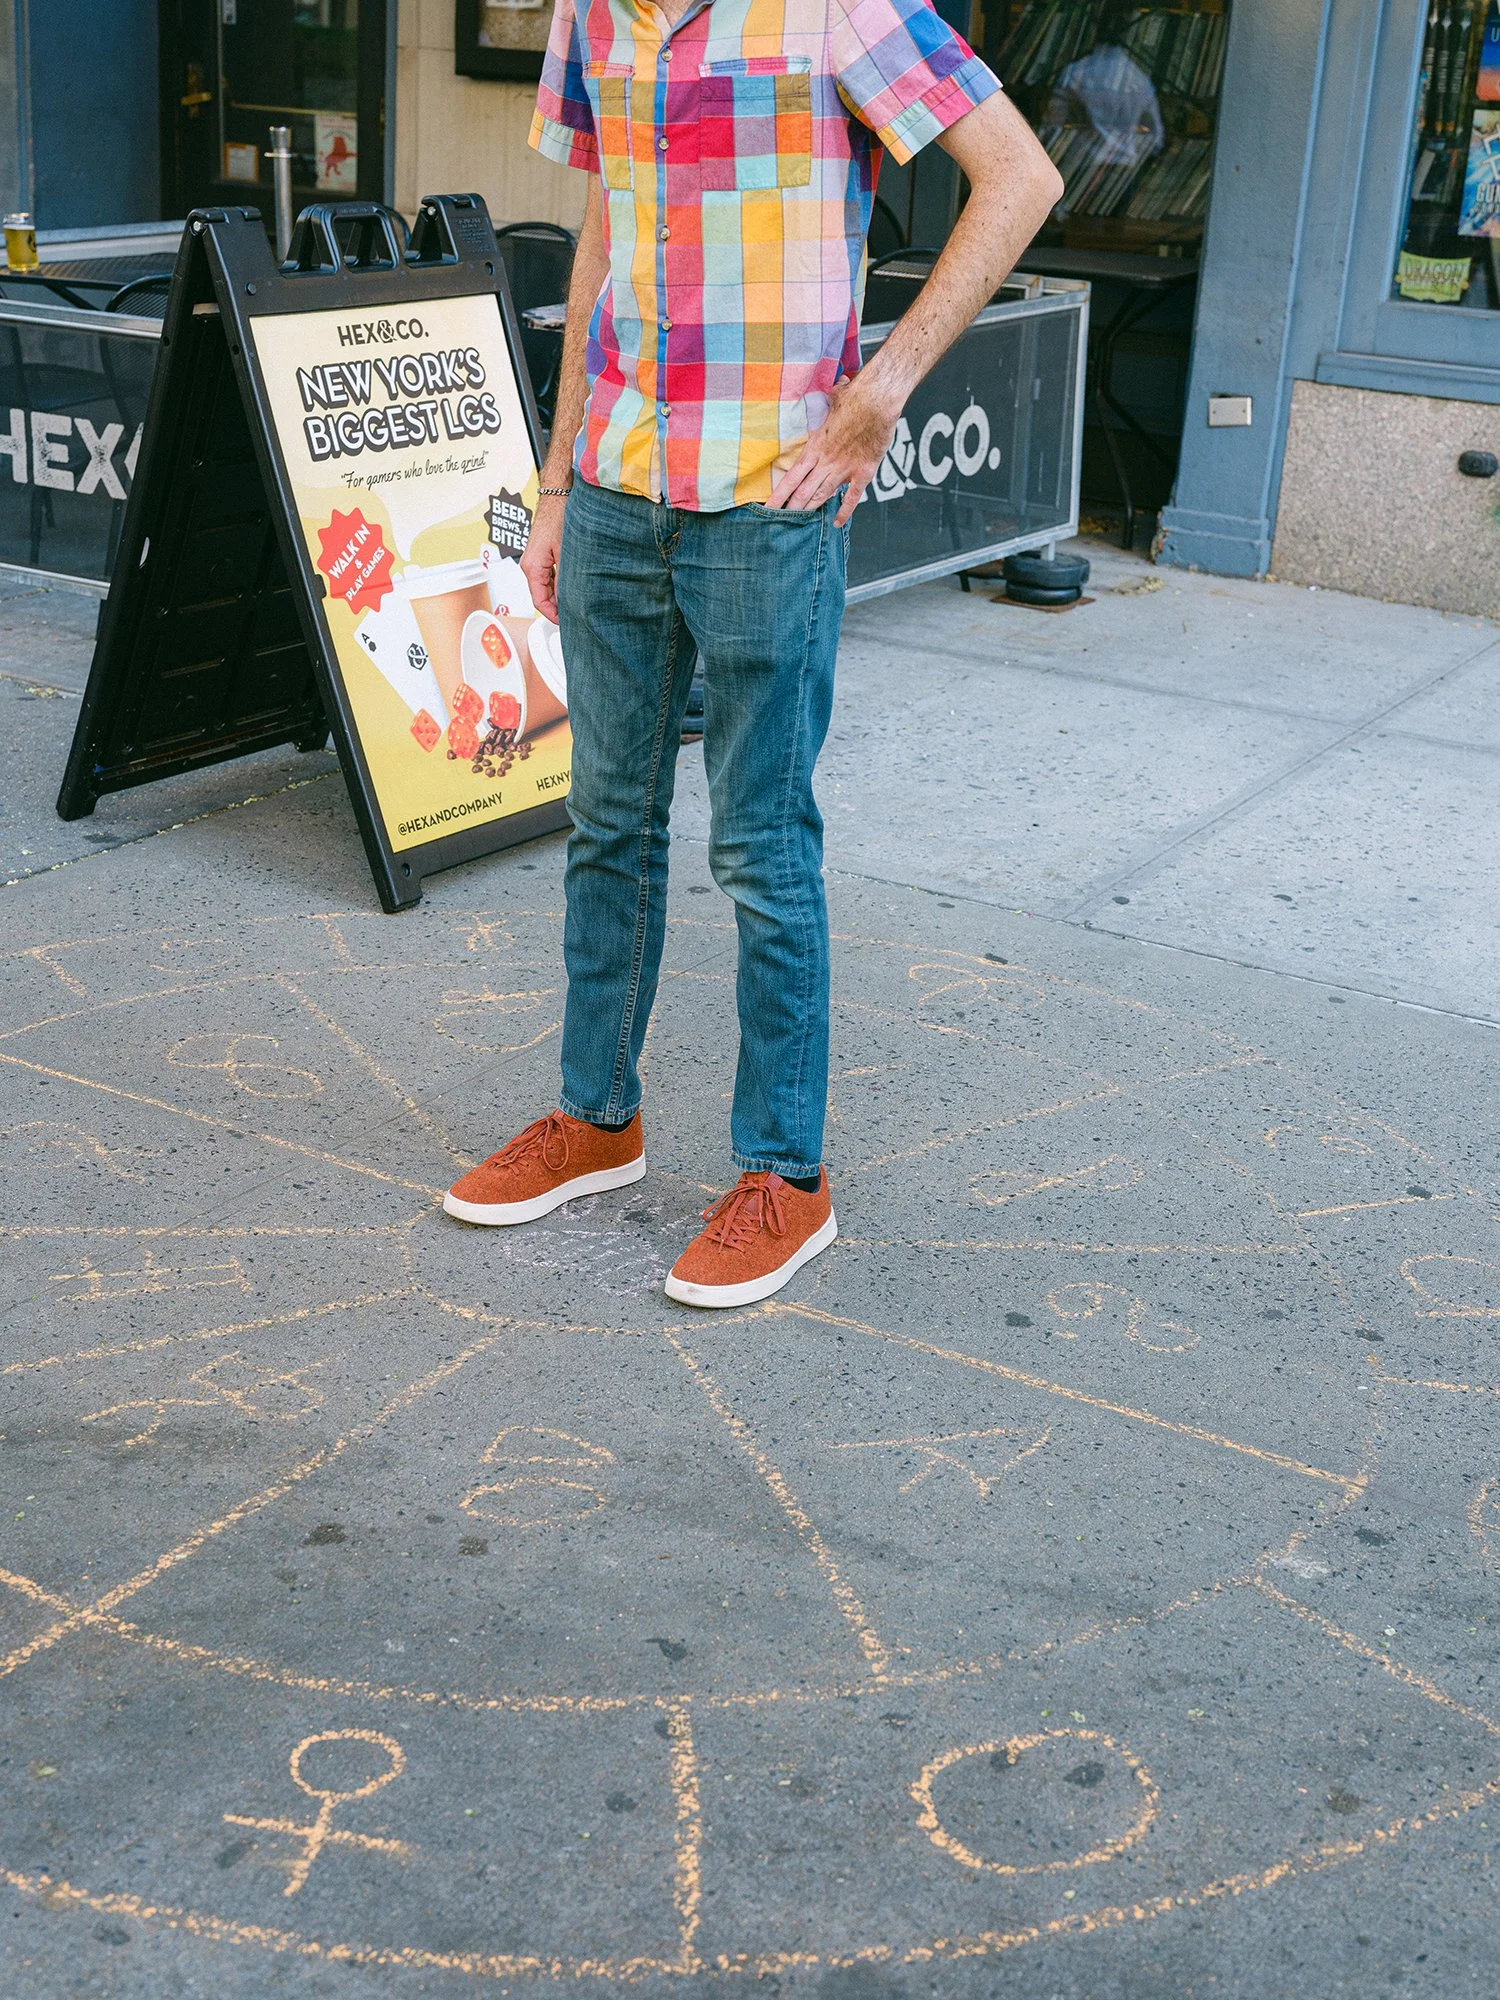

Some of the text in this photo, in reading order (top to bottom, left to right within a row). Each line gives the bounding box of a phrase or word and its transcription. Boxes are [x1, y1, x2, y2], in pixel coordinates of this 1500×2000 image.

[296, 347, 486, 412] NEW YORK'S
[0, 408, 144, 500] HEX
[303, 392, 501, 462] BIGGEST LGS
[366, 470, 402, 491] gamers
[404, 461, 422, 480] who
[425, 459, 444, 476] love
[445, 455, 459, 471] the
[492, 498, 530, 526] BEER,
[328, 523, 371, 579] WALK IN
[345, 546, 385, 601] PLAY GAMES
[354, 558, 363, 570] &
[398, 792, 503, 836] @HEXANDCOMPANY
